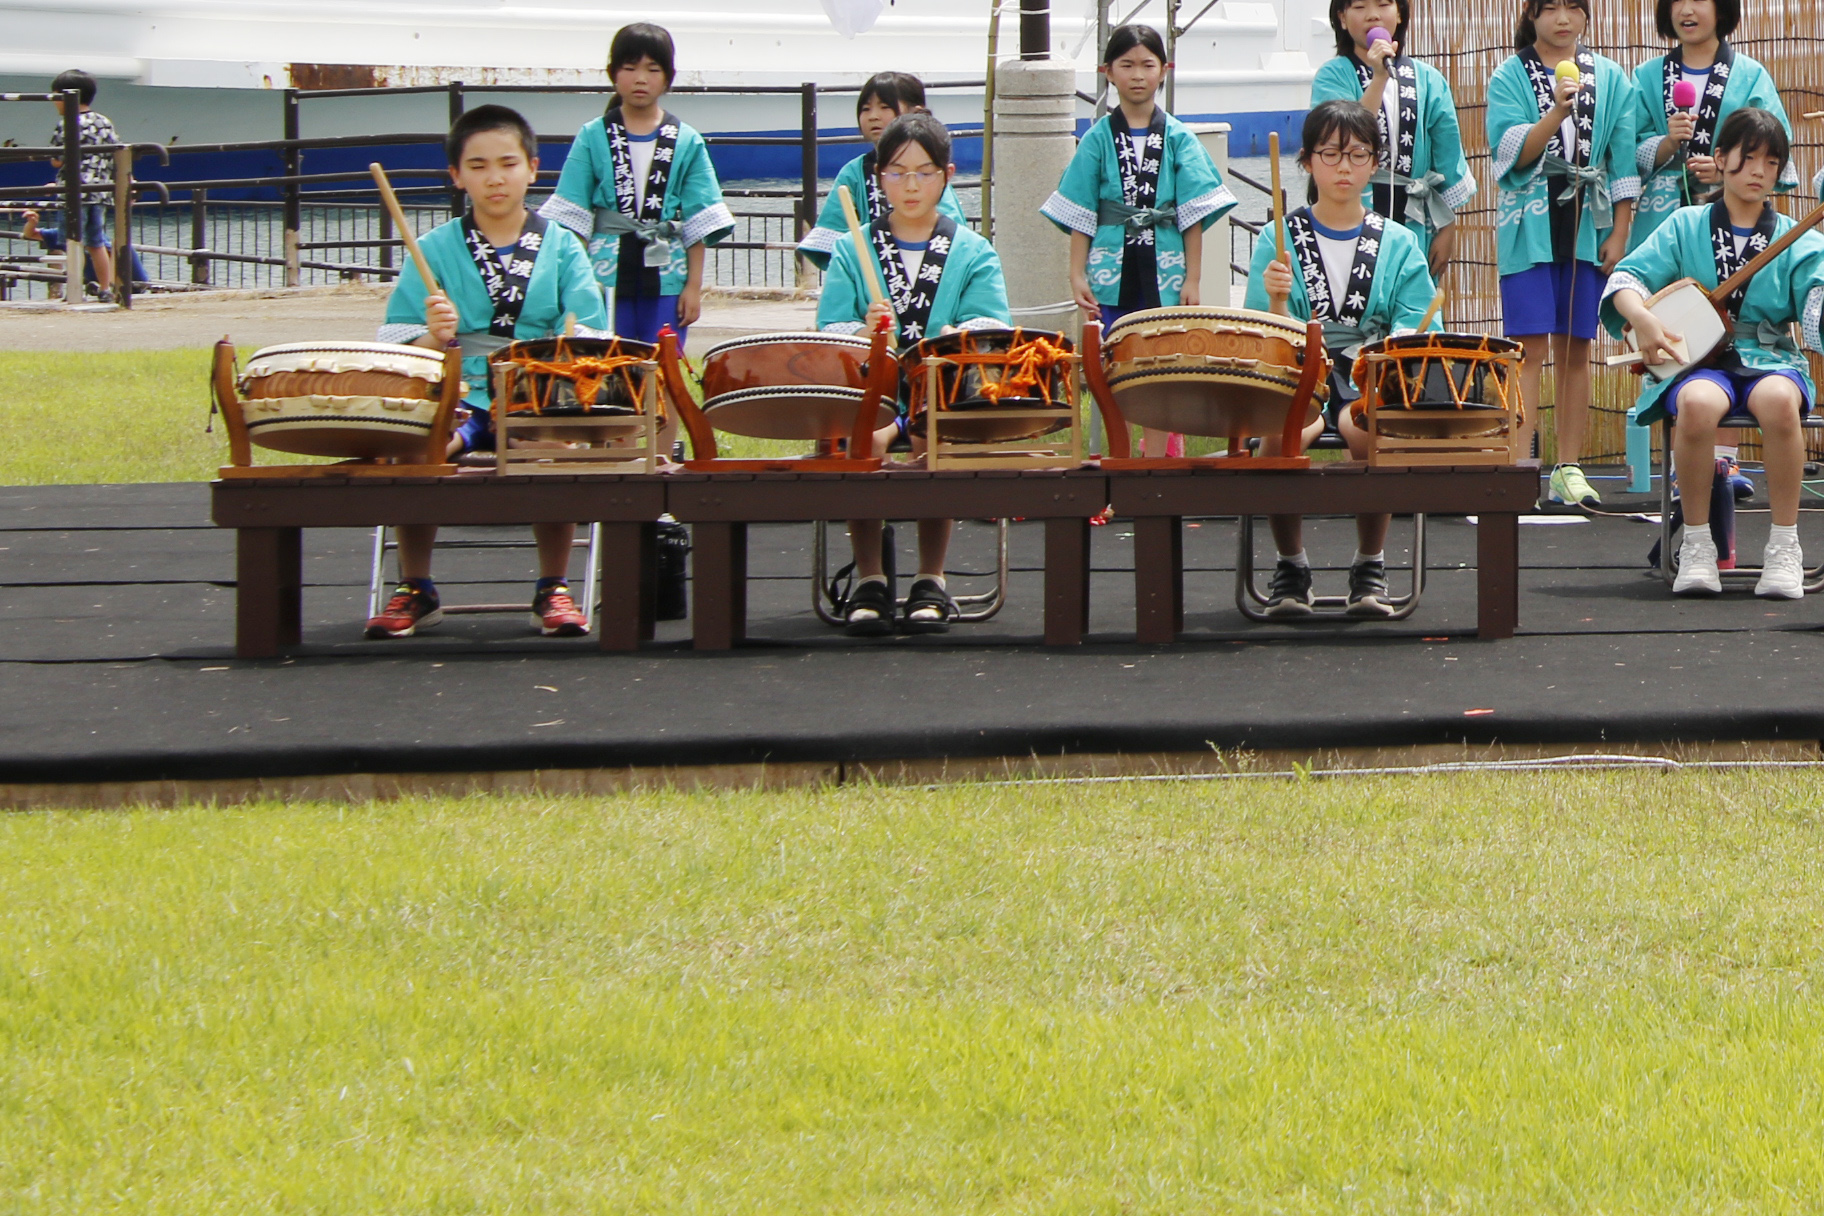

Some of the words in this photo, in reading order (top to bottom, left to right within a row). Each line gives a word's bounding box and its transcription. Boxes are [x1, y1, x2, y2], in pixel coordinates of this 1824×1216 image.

[1397, 65, 1417, 173] 佐渡小木港
[1692, 62, 1730, 156] 佐渡小木
[641, 124, 678, 225] 佐渡小木
[1138, 133, 1163, 246] 佐渡小港
[493, 232, 542, 327] 佐渡小木
[902, 234, 950, 340] 佐渡小木
